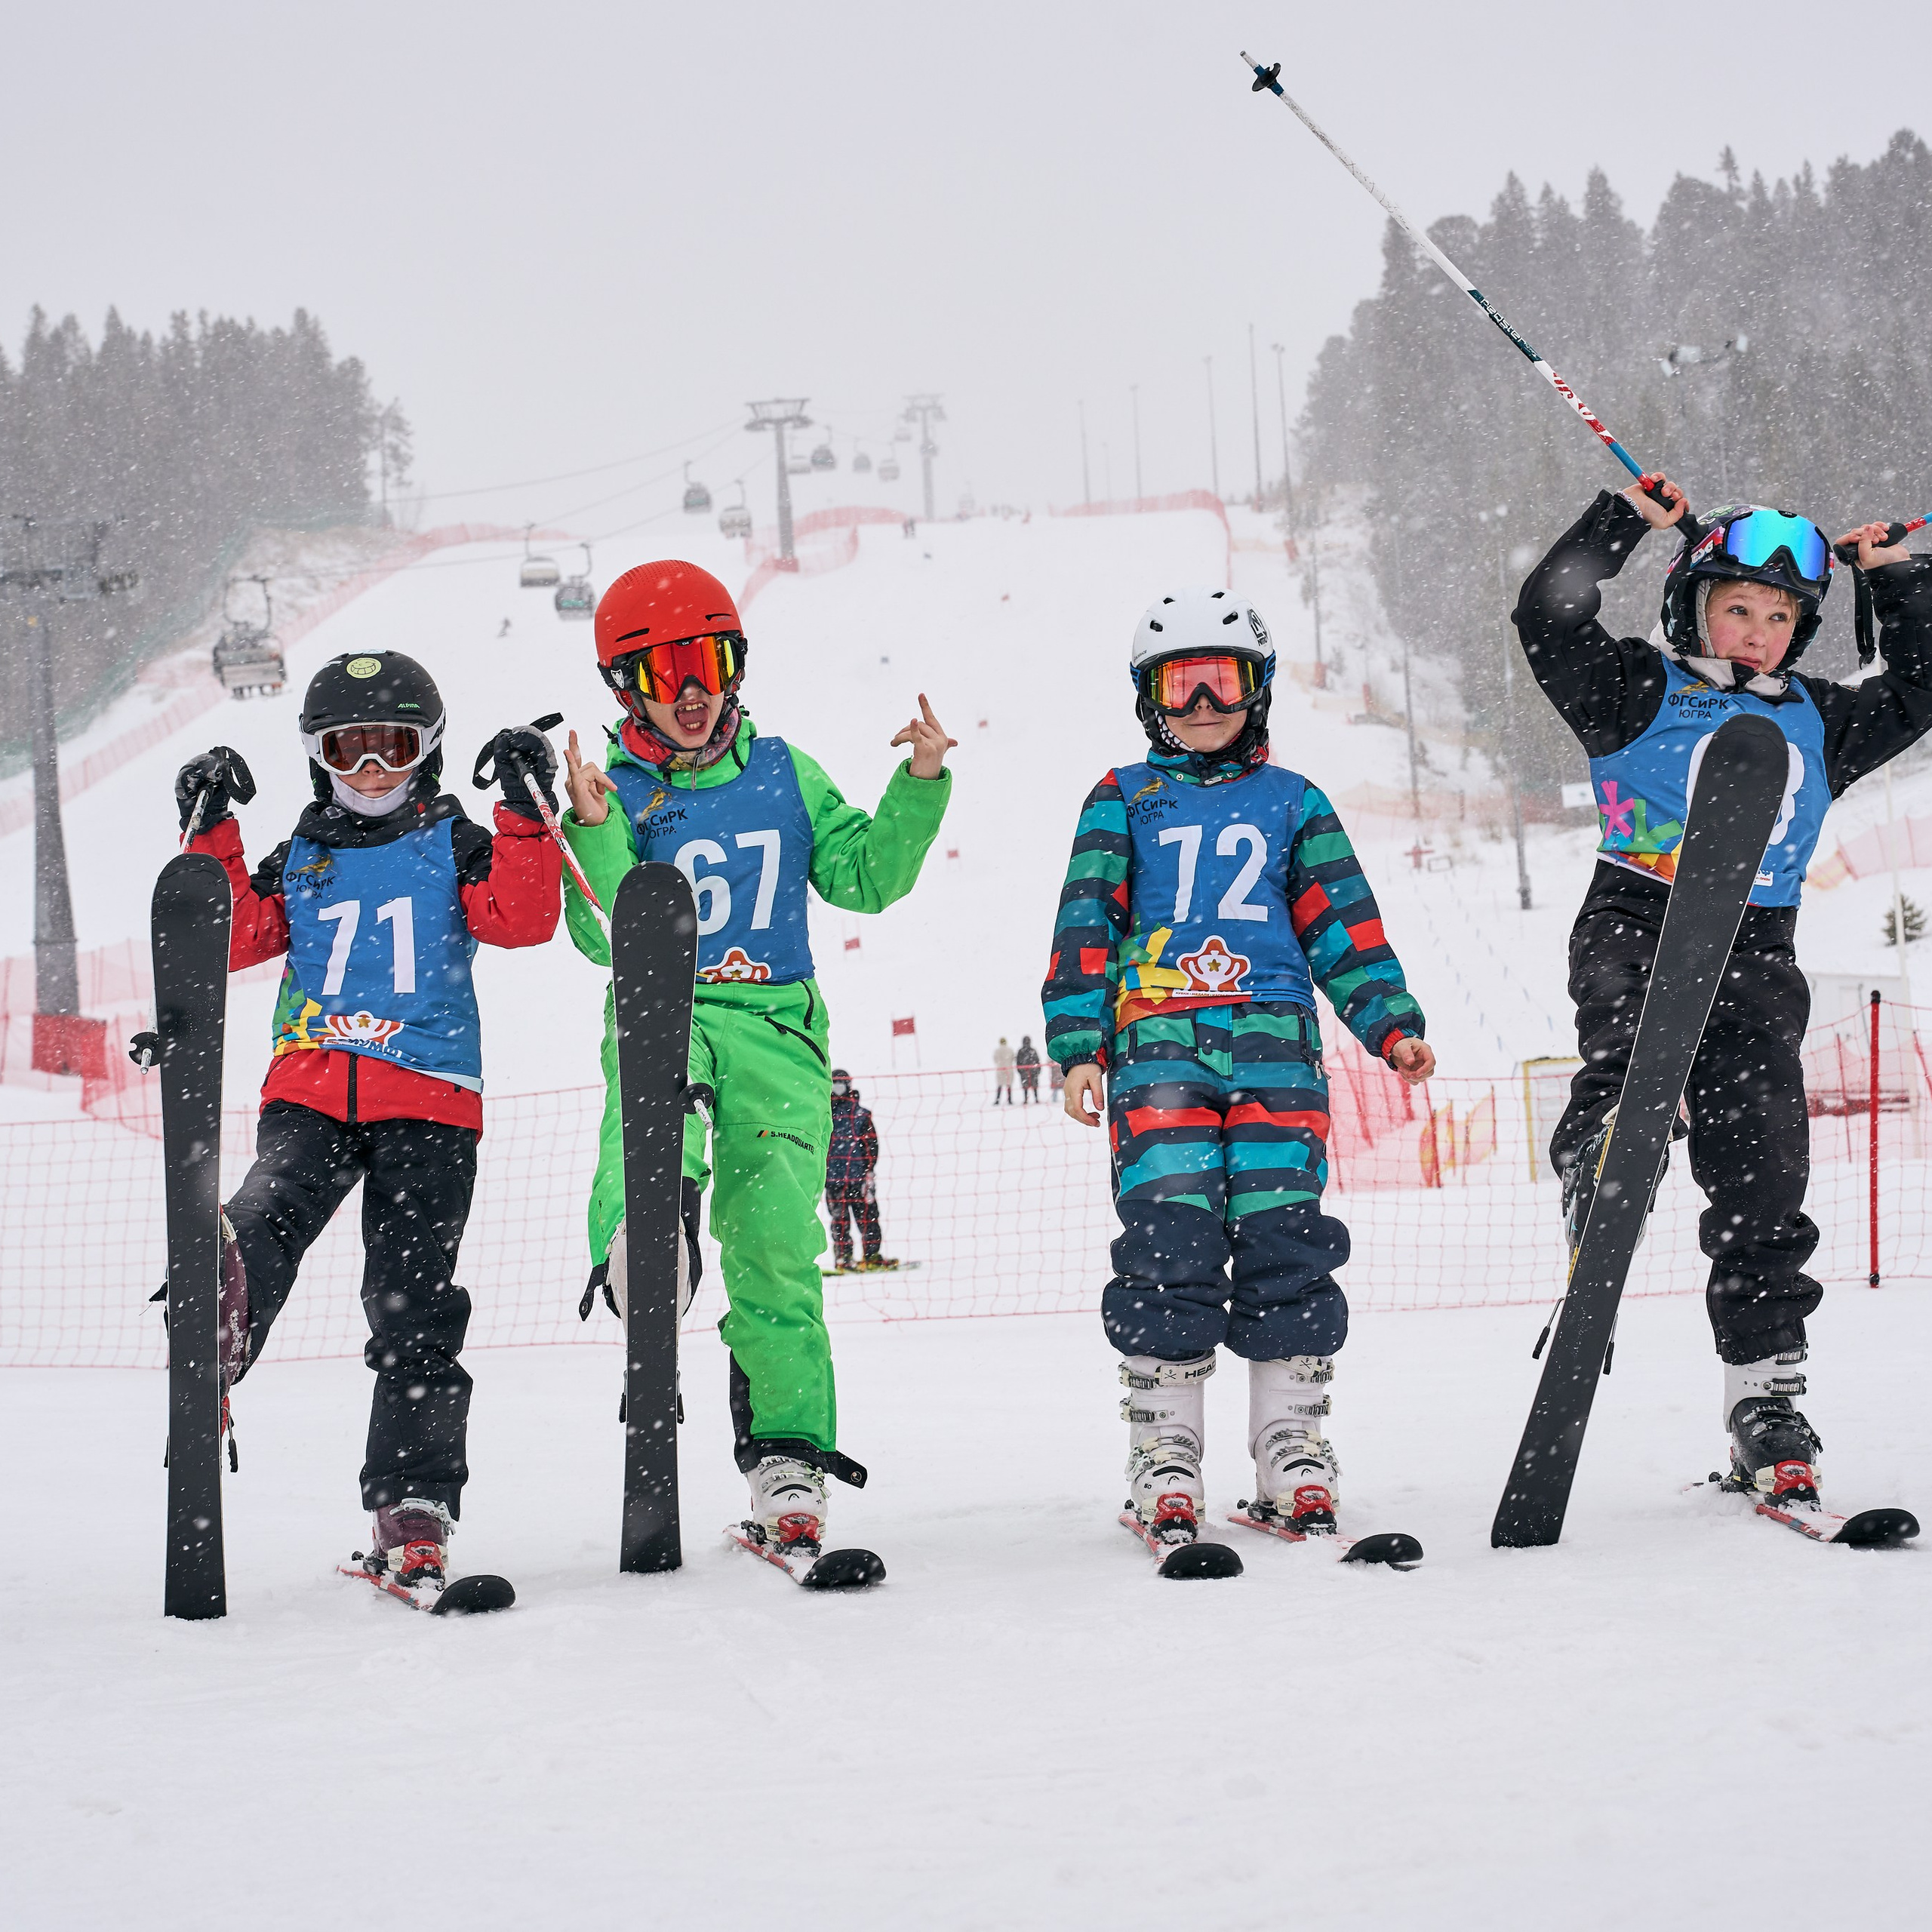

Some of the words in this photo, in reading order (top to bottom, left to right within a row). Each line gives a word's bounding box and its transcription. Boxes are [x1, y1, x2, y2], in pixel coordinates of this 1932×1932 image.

[1667, 693, 1731, 709] ФГСиРК
[1678, 709, 1712, 719] ЮГРА
[1140, 811, 1164, 826] ЮГРА
[674, 829, 781, 936] 67
[1158, 823, 1268, 923] 72
[318, 897, 415, 995] 71
[1184, 1360, 1217, 1380] HEAD
